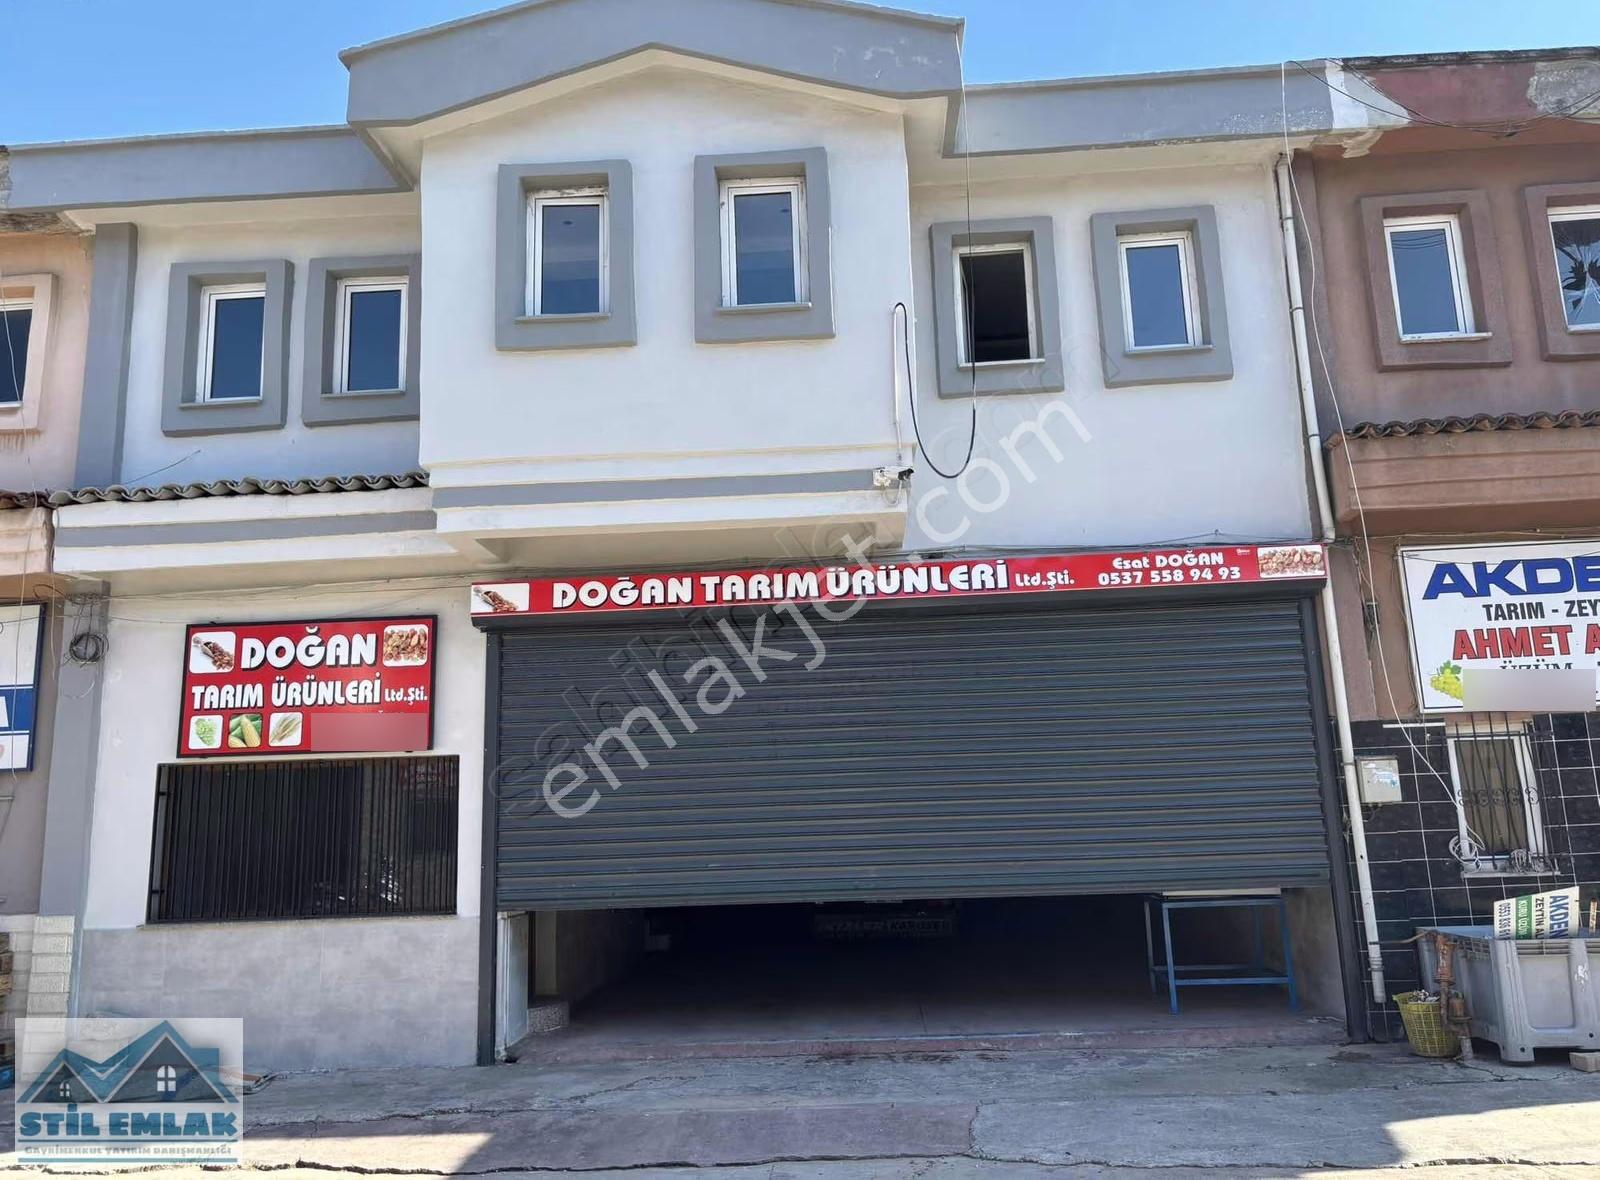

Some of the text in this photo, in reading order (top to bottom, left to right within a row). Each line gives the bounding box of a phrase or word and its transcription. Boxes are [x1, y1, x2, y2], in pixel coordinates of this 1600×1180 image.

[1097, 566, 1241, 586] 0537 558 94 93
[1112, 556, 1150, 569] Esat
[1155, 549, 1224, 568] DOĞAN
[552, 576, 693, 609] DOĞAN
[700, 571, 820, 603] TARIM
[825, 559, 1009, 597] ÜRÜNLERİ
[1482, 601, 1545, 621] TARIM
[240, 625, 377, 670] DOĞAN
[1452, 624, 1573, 660] AHMET
[192, 682, 264, 711] TARIM
[271, 672, 383, 708] ÜRÜNLERİ
